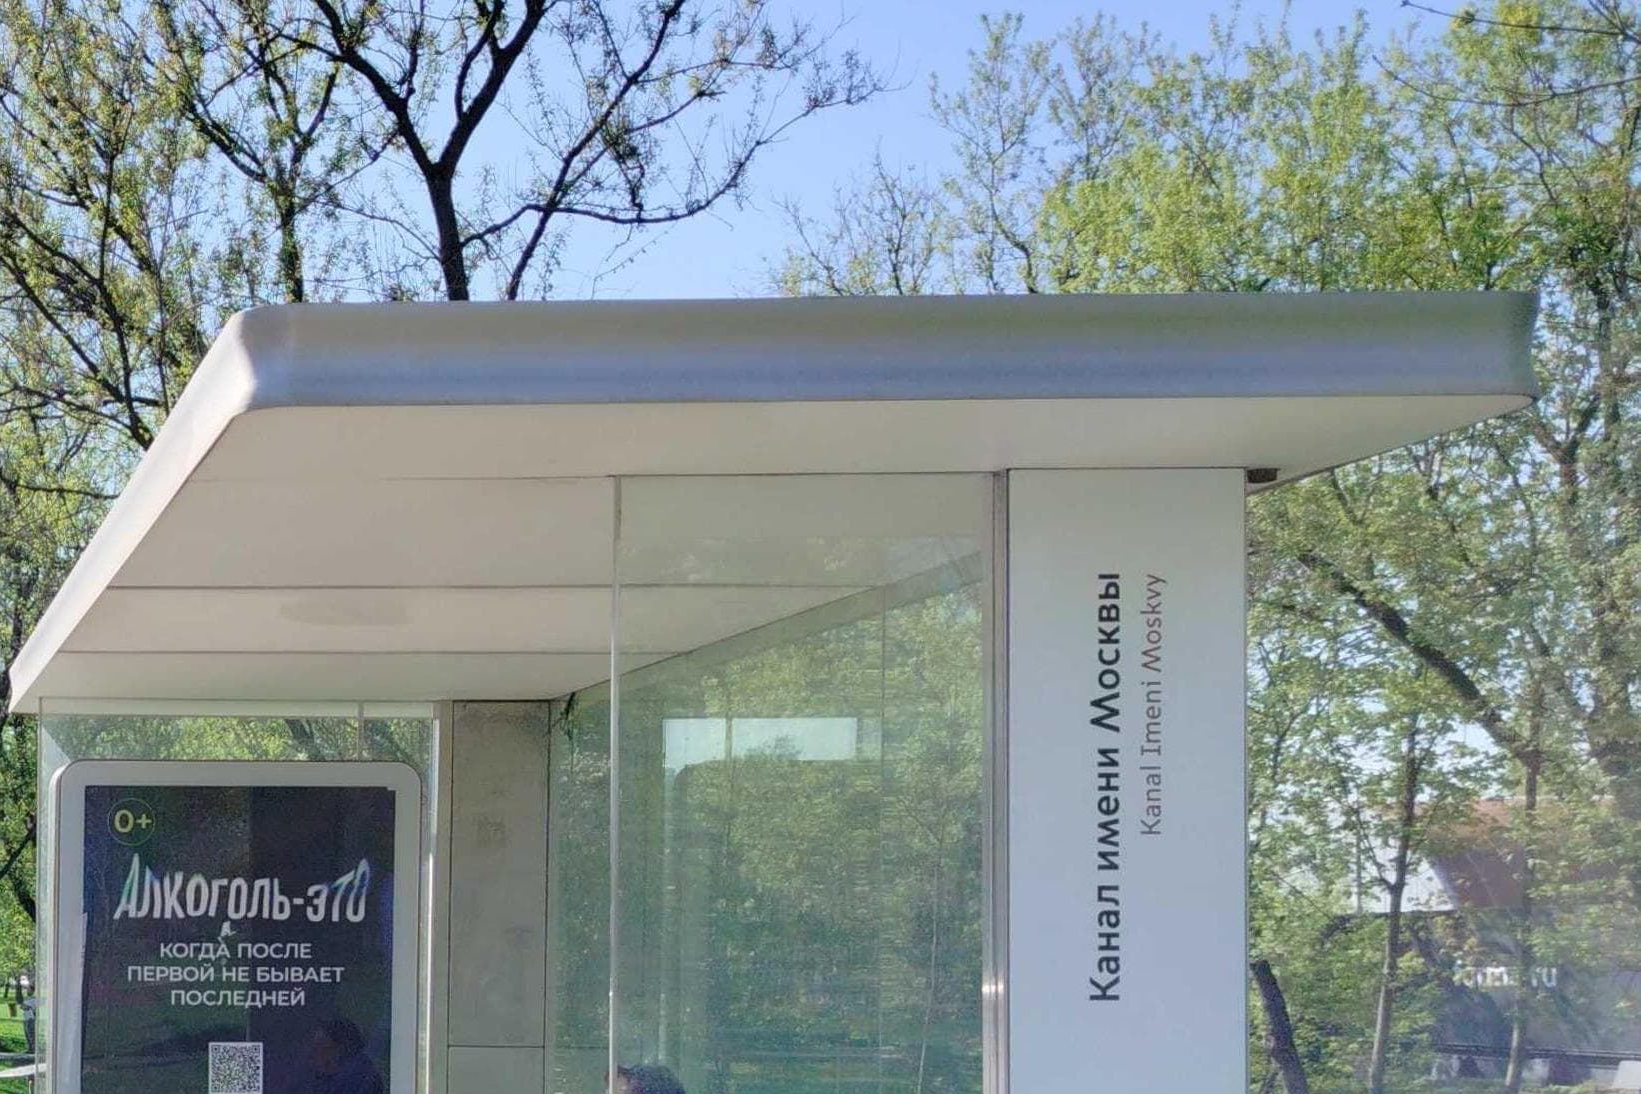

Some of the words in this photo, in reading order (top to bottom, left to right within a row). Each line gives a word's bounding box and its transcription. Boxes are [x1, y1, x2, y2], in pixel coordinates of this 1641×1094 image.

[1089, 573, 1121, 733] Москвы
[1139, 573, 1168, 673] Moskvy
[1139, 680, 1162, 757] Imeni
[1096, 747, 1120, 871] имени
[1139, 765, 1162, 835] Kanal
[127, 963, 214, 983] ПЕРВОЙ
[222, 966, 251, 983] НЕ
[256, 966, 346, 983] БЫВАЕТ
[159, 942, 232, 961] КОГДА
[237, 942, 313, 959] ПОСЛЕ
[1089, 884, 1121, 1001] Канал
[170, 986, 306, 1008] ПОСЛЕДНЕЙ
